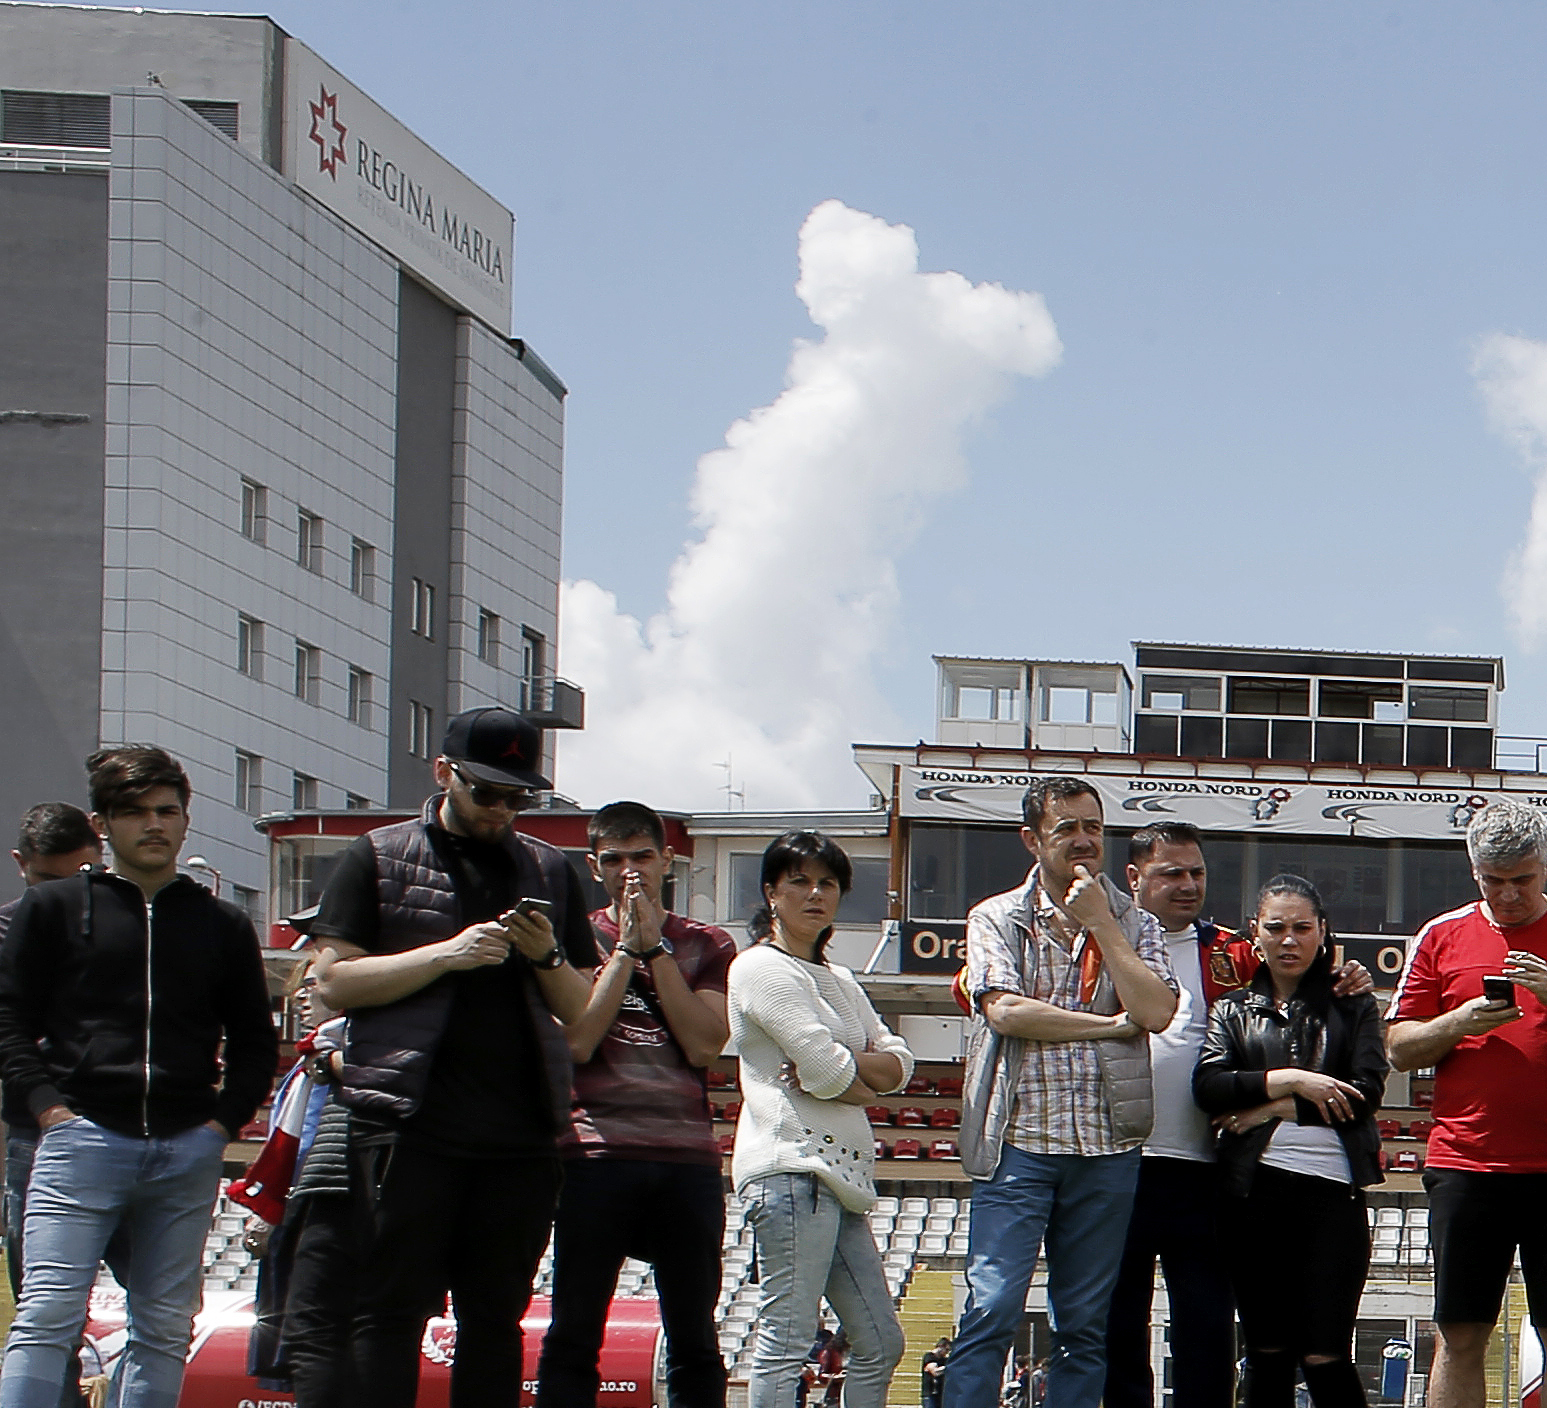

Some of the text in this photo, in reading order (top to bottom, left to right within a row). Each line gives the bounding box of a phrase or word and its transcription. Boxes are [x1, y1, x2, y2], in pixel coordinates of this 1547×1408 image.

[357, 138, 437, 234] REGINA
[441, 205, 504, 284] MARIA
[920, 770, 993, 784] HONDA
[1128, 780, 1263, 797] HONDA NORD
[1327, 788, 1460, 804] HONDA NORD
